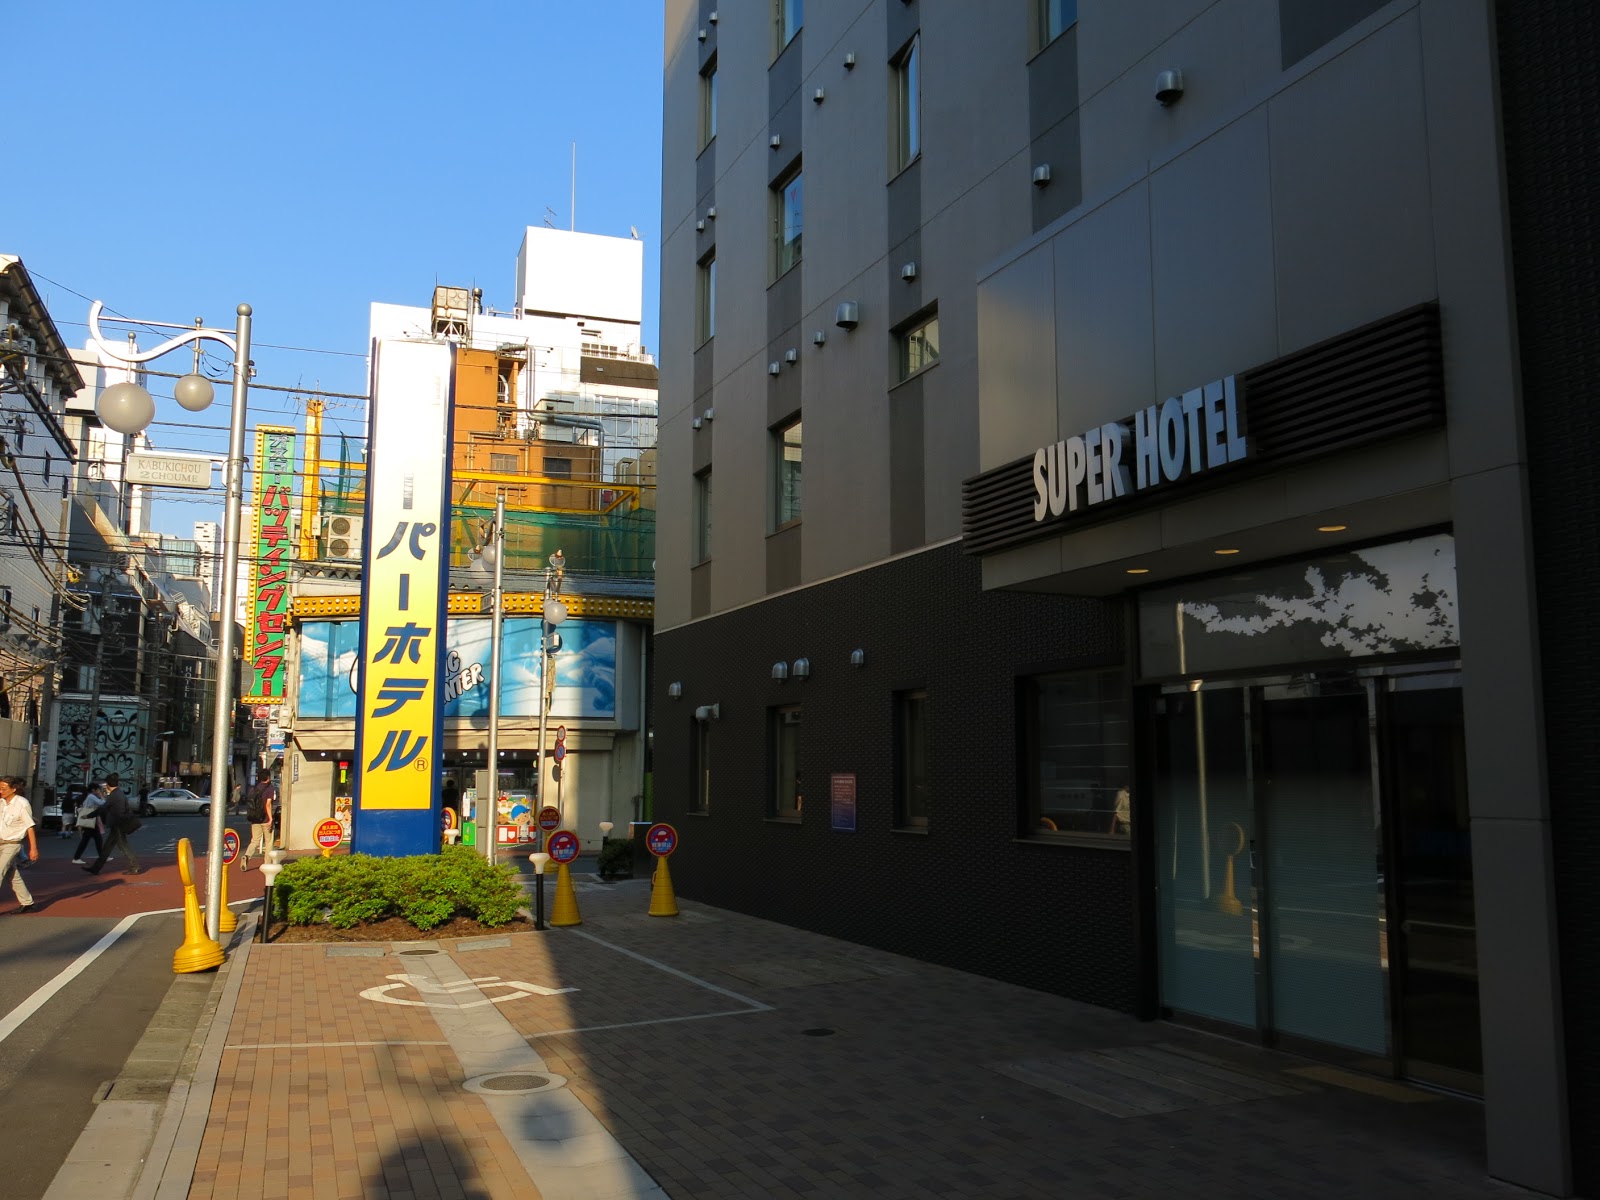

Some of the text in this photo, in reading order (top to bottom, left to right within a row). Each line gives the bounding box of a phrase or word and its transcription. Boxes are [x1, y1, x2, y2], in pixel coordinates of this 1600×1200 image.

[138, 460, 201, 474] KABUKICHOU
[1033, 374, 1247, 522] SUPER HOTEL
[140, 471, 199, 483] 2 CHOUME
[367, 378, 437, 773] ーパーホテル
[444, 662, 486, 705] NTER
